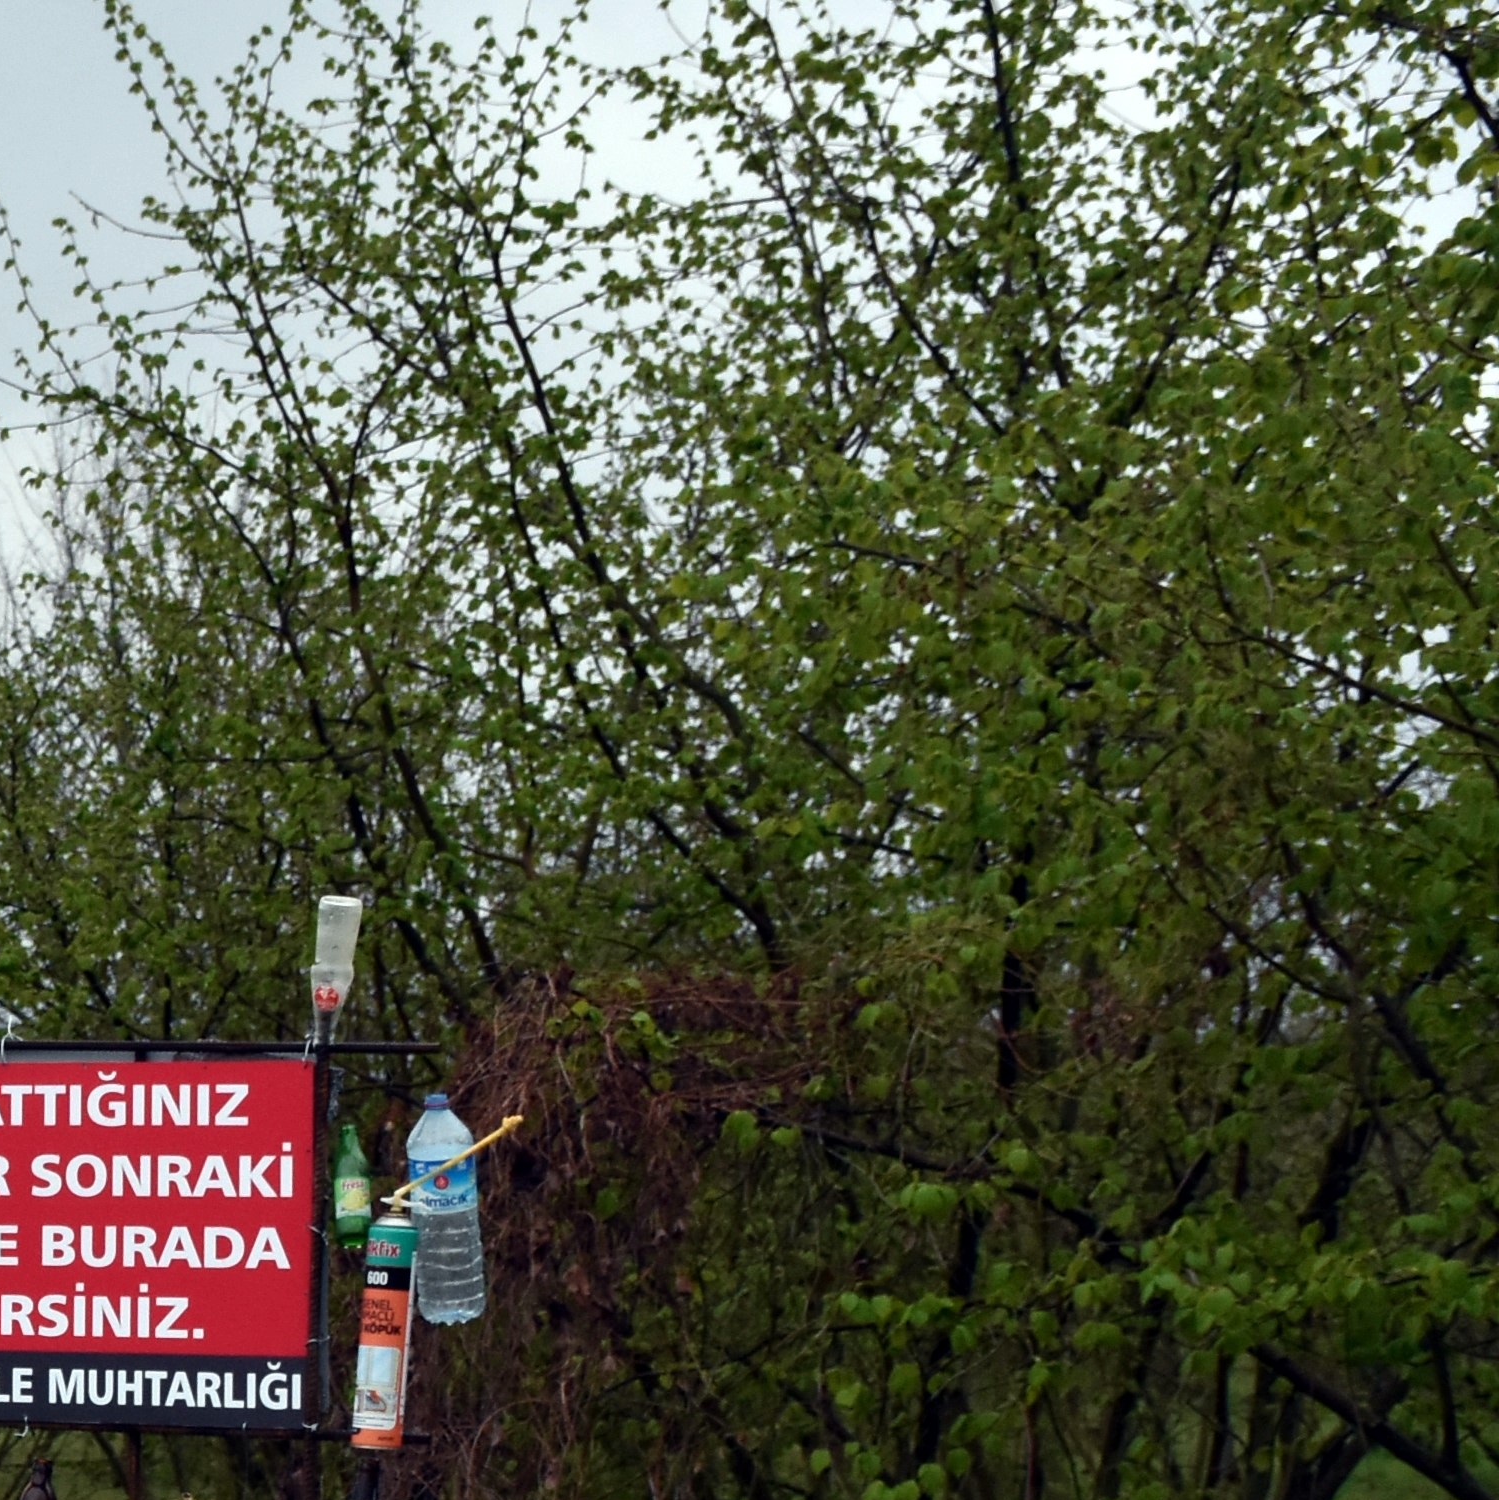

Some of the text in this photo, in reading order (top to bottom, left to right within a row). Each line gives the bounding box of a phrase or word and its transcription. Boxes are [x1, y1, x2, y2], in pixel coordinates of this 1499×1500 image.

[32, 1143, 293, 1197] SONRAKİ
[42, 1225, 290, 1269] BURADA
[367, 1271, 388, 1285] 600
[362, 1299, 393, 1311] ENEL
[49, 1362, 301, 1409] MUHTARLIĞI
